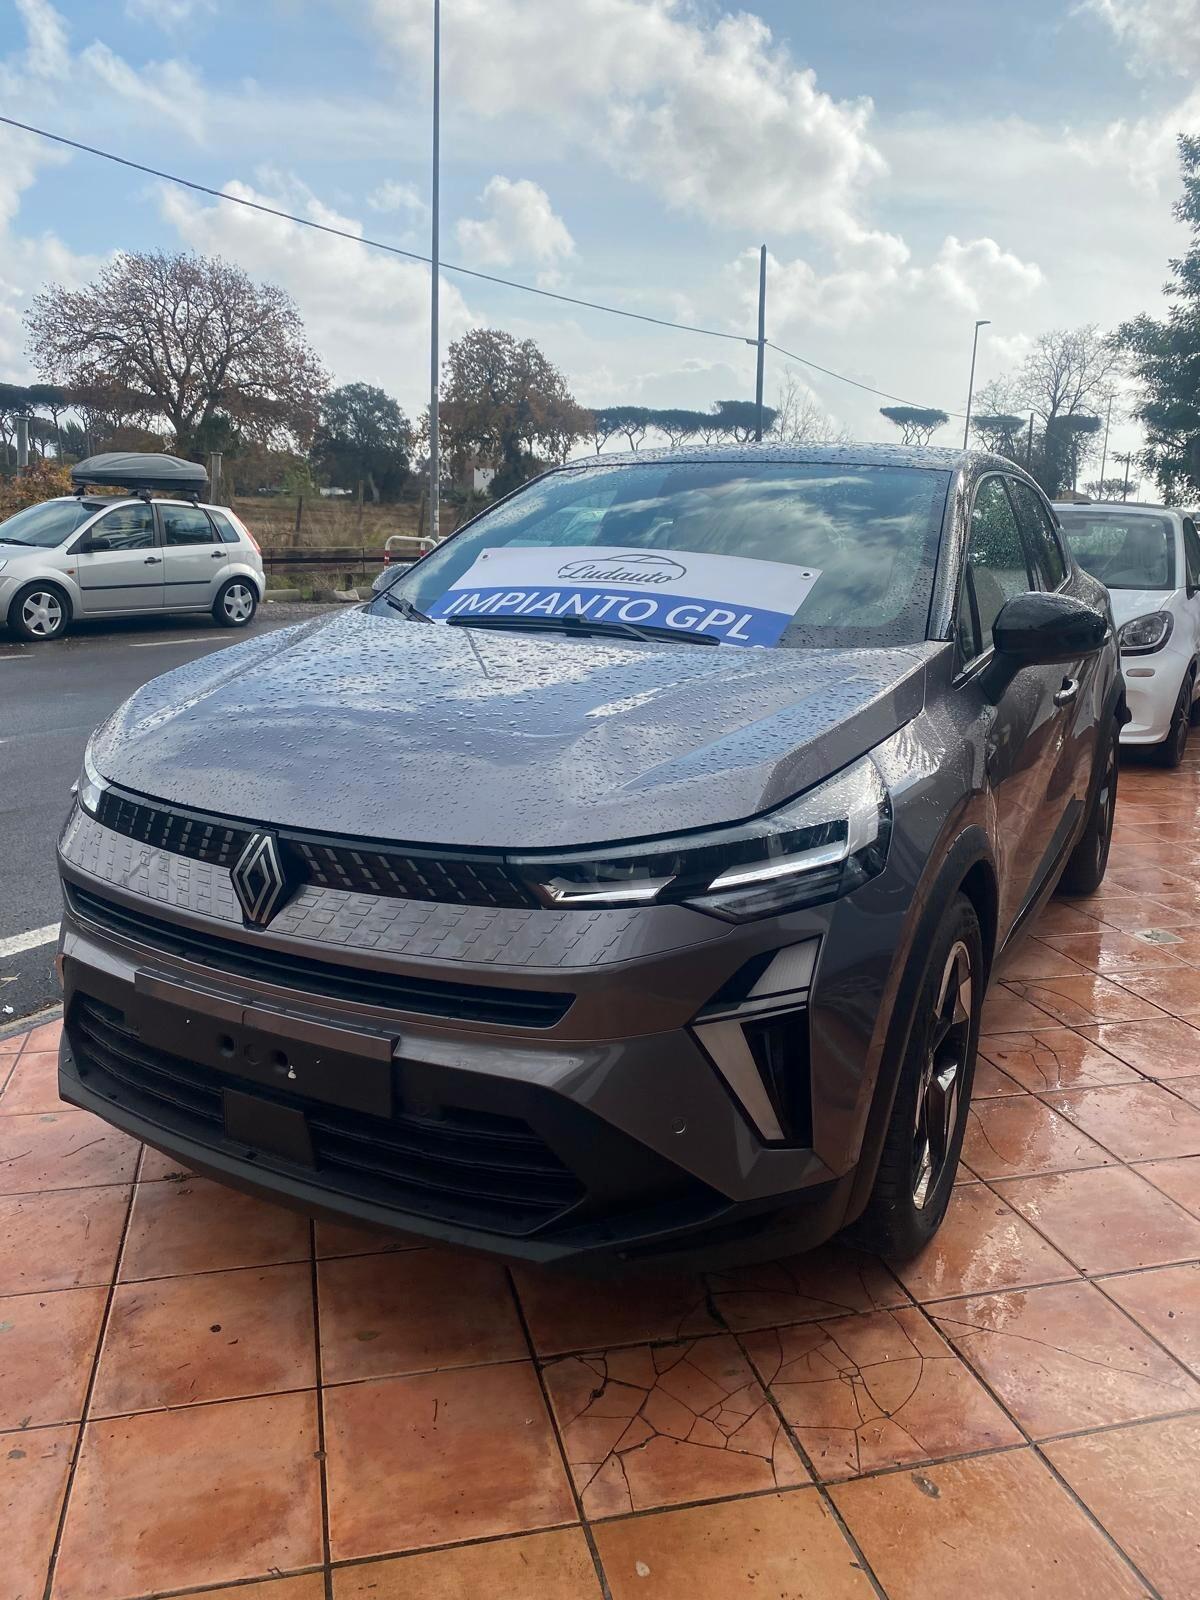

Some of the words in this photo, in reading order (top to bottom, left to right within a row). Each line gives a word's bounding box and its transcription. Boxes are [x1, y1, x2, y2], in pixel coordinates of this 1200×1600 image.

[558, 563, 672, 584] Ludauto
[442, 592, 658, 622] IMPIANTO
[666, 604, 753, 640] GPL
